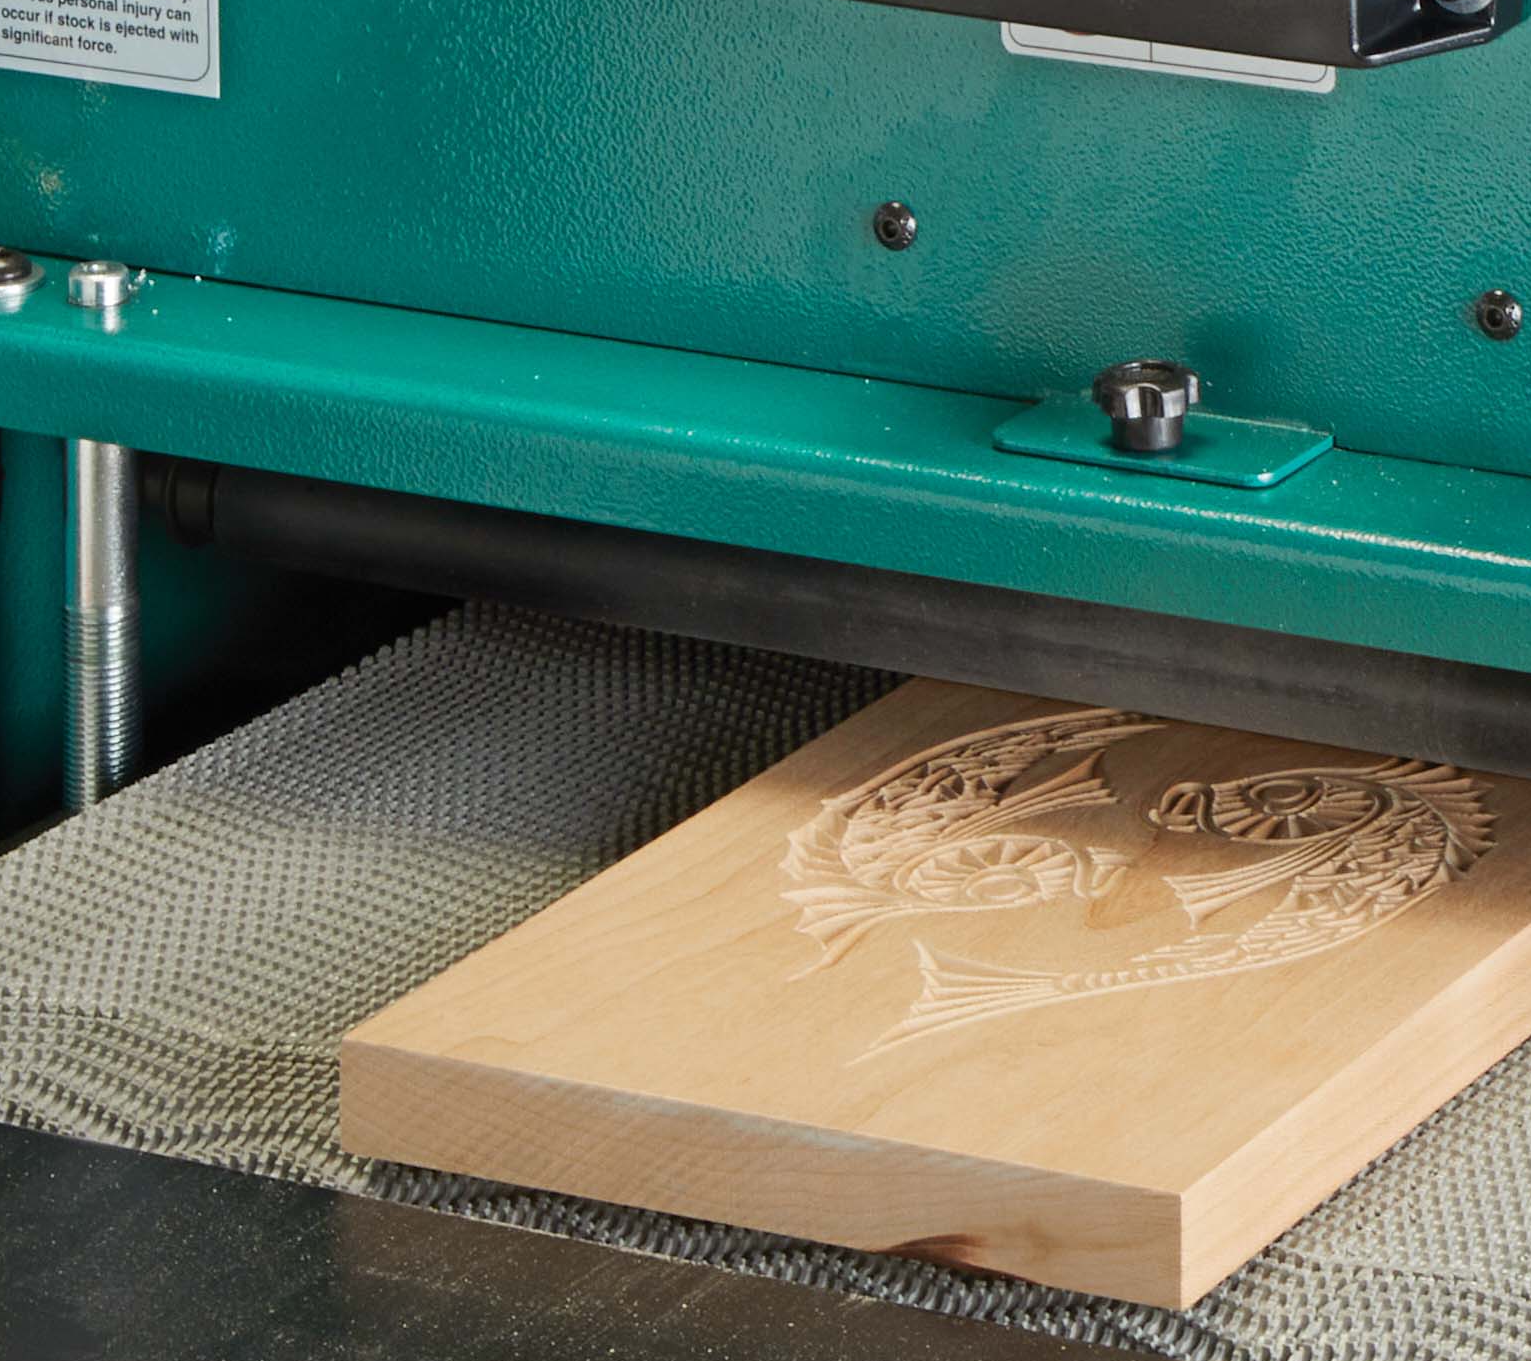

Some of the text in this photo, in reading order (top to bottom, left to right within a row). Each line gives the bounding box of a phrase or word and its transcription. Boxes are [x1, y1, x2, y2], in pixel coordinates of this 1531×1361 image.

[122, 0, 162, 22] injury
[166, 8, 191, 22] can
[1, 7, 199, 45] occur if stock is ejected with
[1, 26, 117, 54] significant force.
